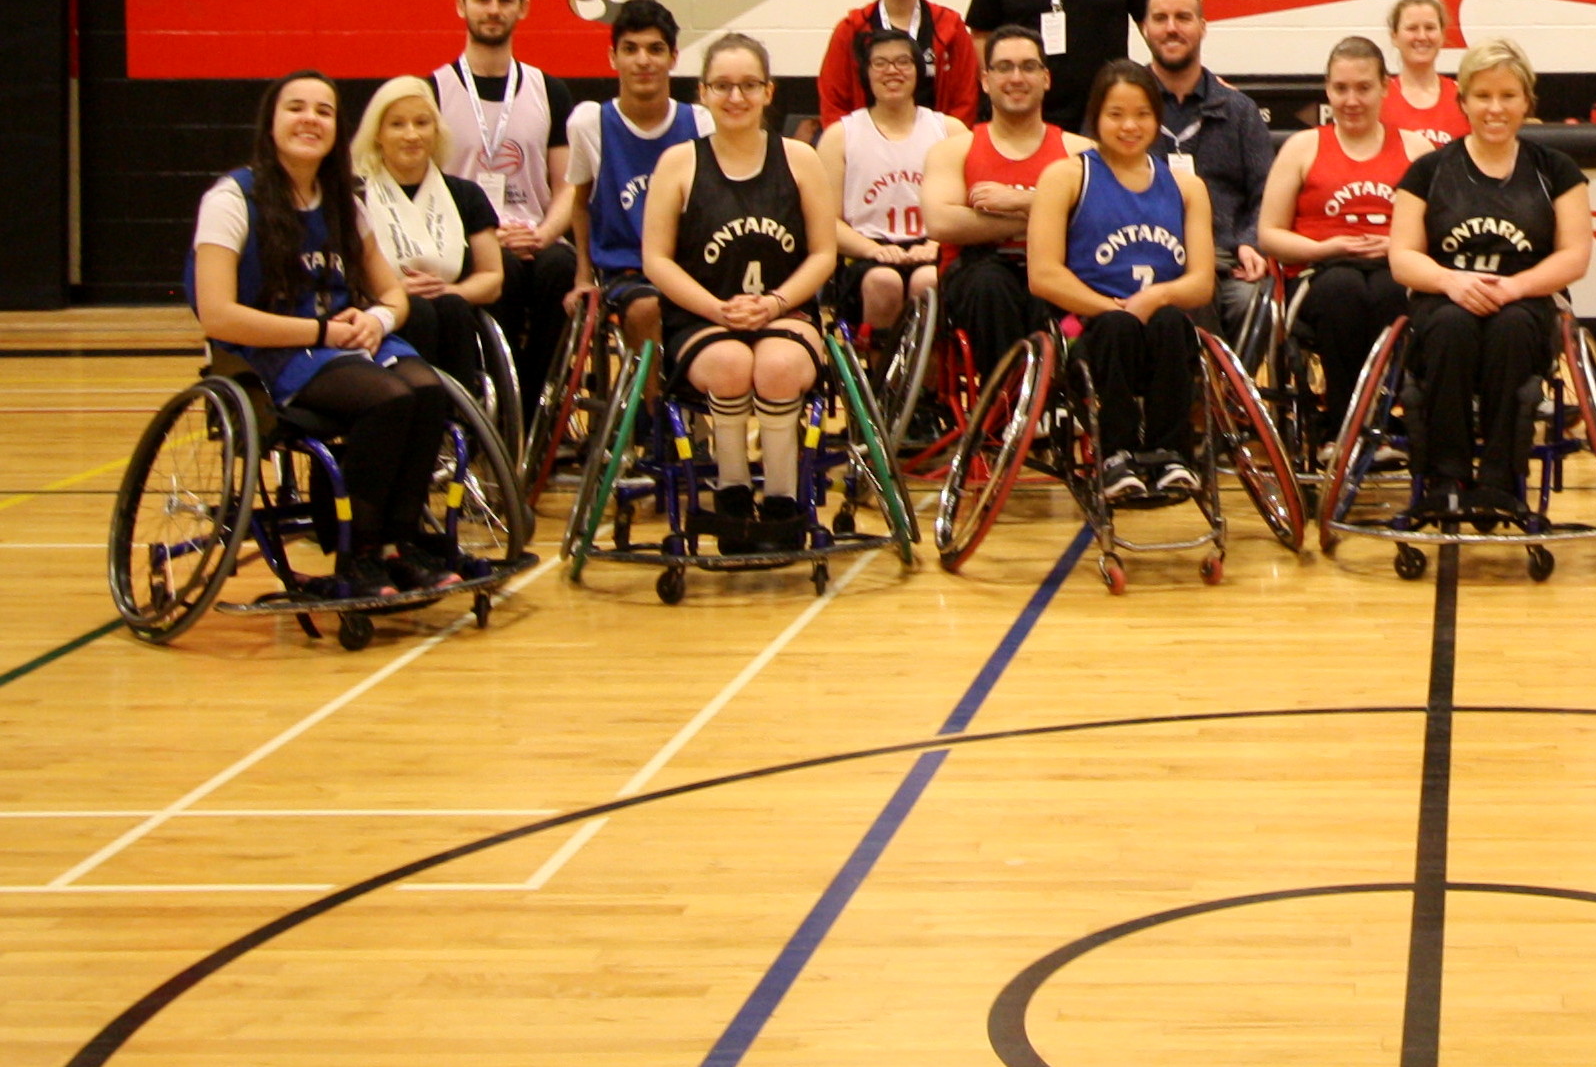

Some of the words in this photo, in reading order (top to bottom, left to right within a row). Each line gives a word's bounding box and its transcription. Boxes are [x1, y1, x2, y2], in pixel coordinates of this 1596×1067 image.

[863, 169, 925, 205] ONTAR
[886, 205, 924, 237] 10
[703, 216, 796, 265] ONTARIO
[1095, 223, 1186, 266] ONTARIO
[741, 260, 765, 296] 4
